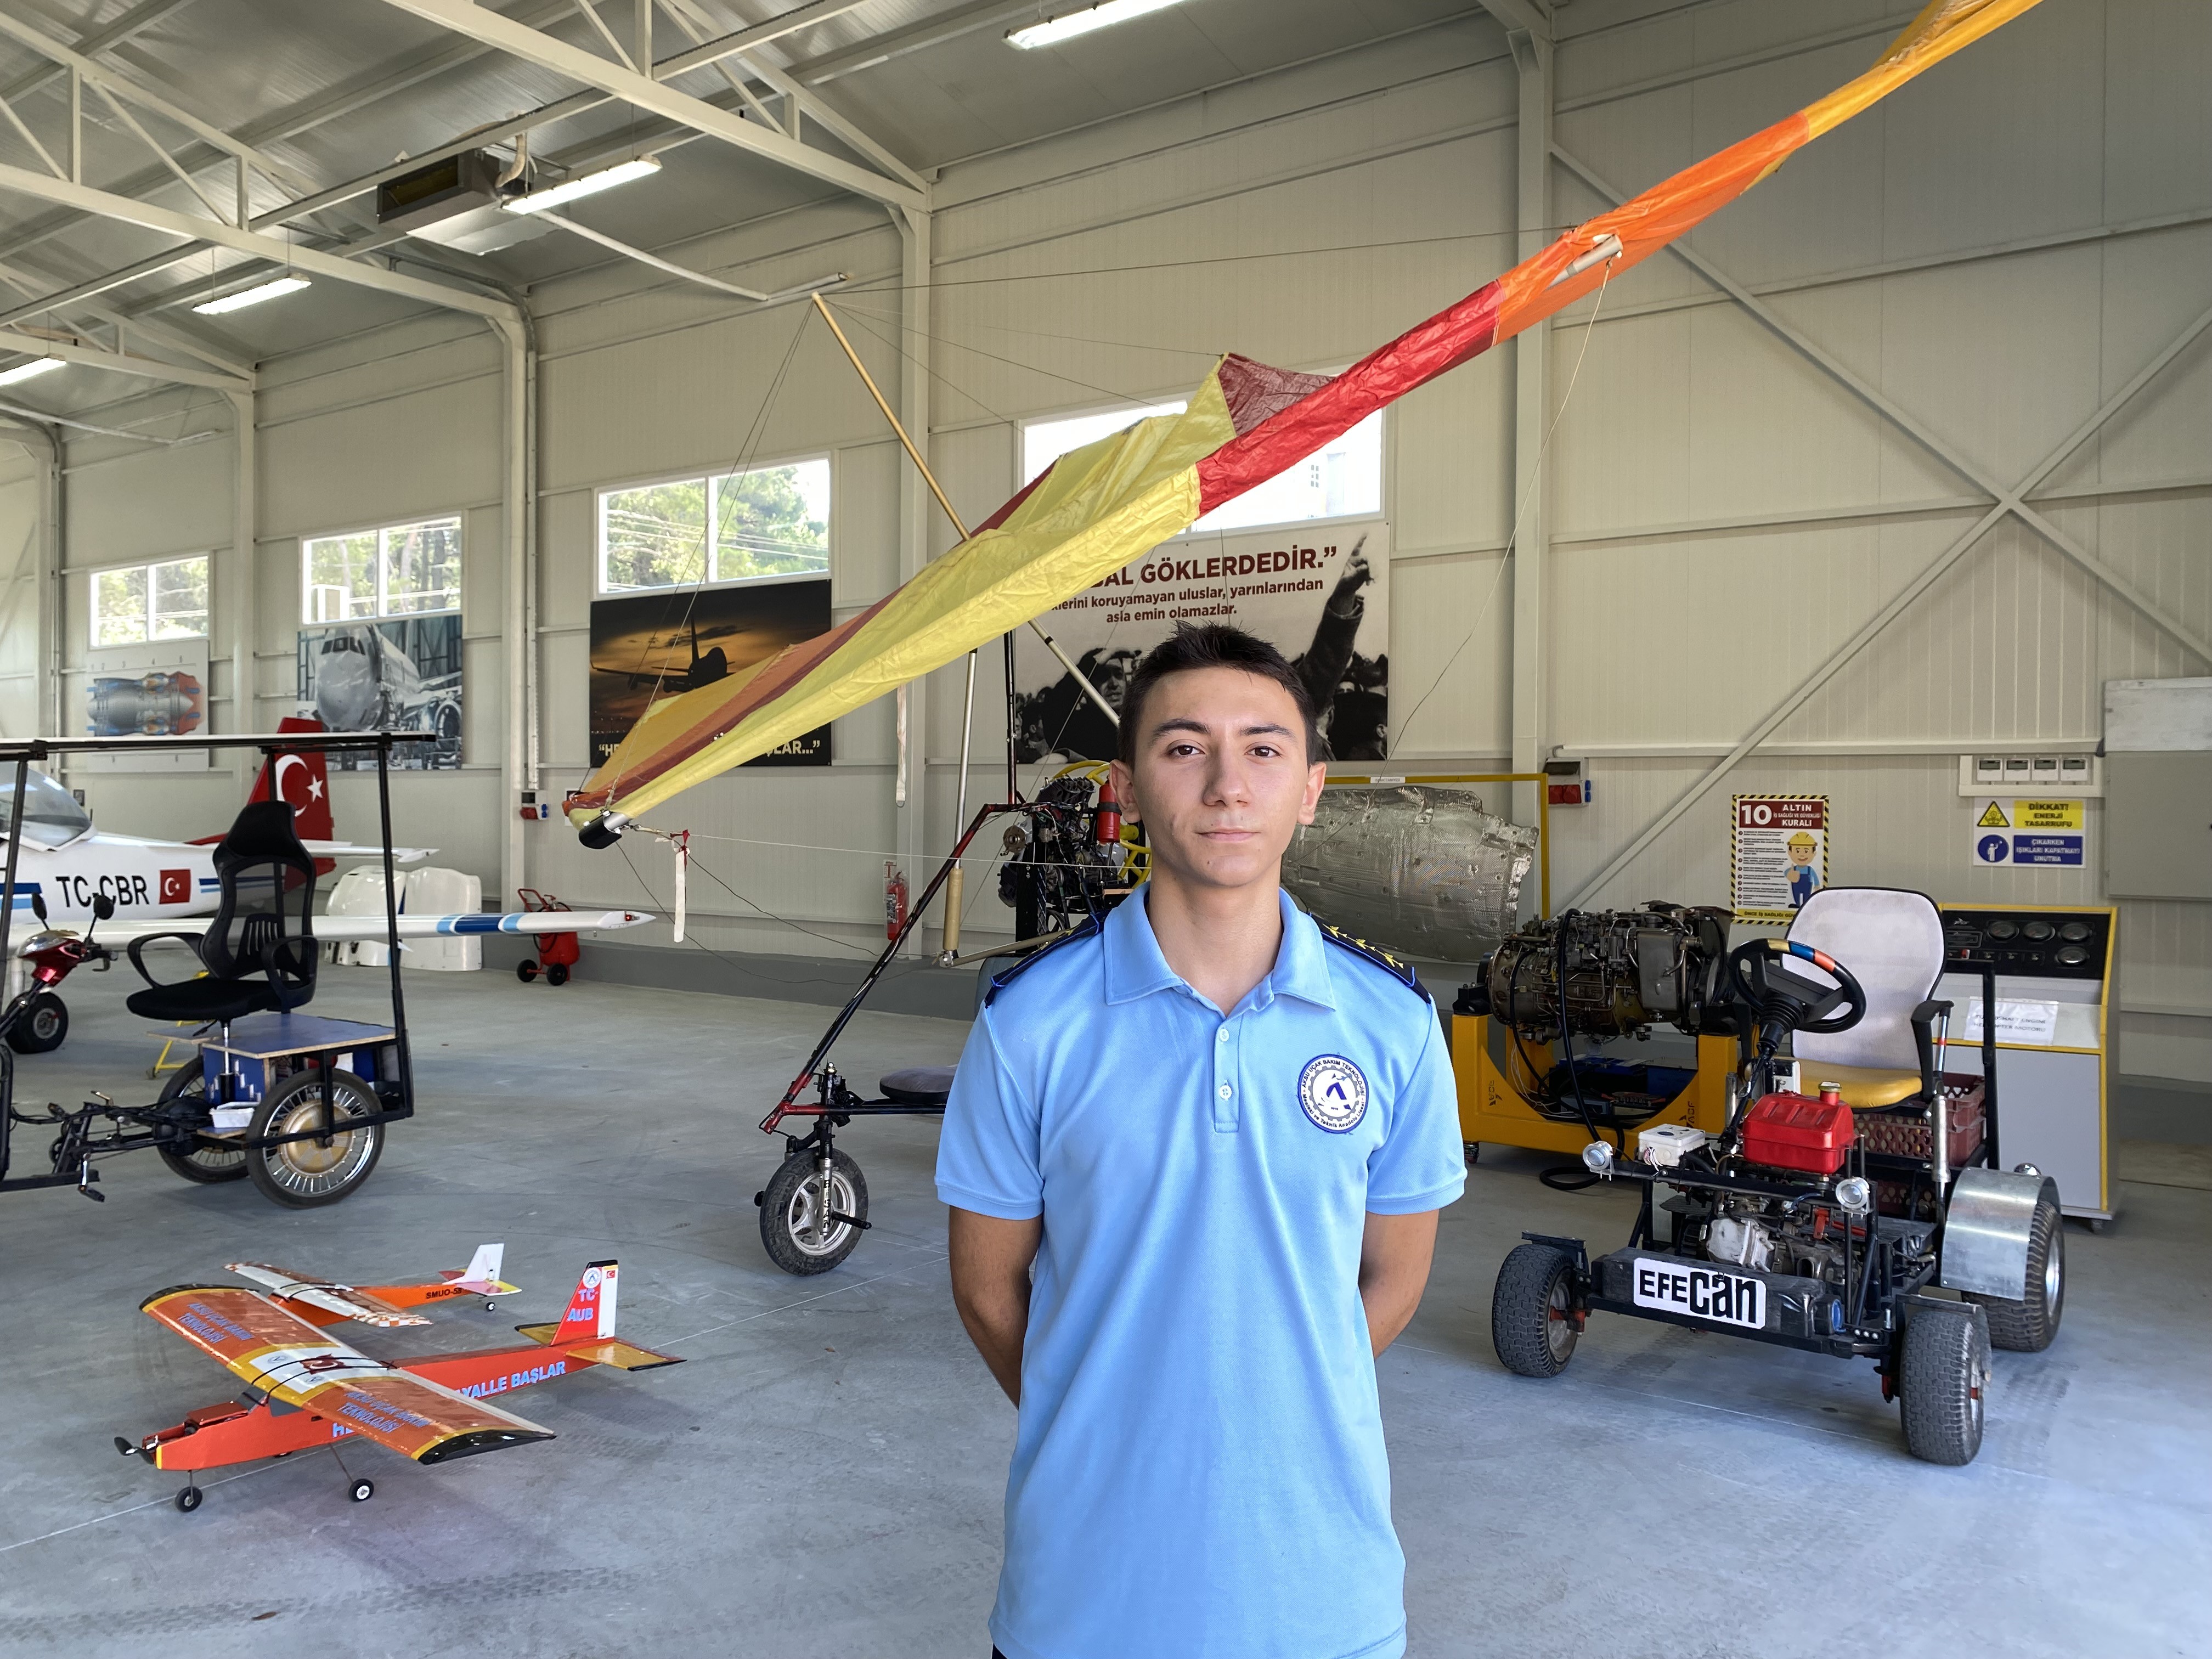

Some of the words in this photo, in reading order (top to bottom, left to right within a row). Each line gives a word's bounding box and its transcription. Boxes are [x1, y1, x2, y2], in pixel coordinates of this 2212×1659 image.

[1141, 545, 1336, 584] GÖKLERDEDİR.”
[1091, 591, 1175, 608] koruyamayan
[1179, 587, 1226, 600] uluslar,
[1229, 578, 1323, 599] yarınlarından
[1106, 611, 1131, 623] asla
[1134, 608, 1165, 621] emin
[1169, 603, 1237, 619] olamazlar.
[1741, 804, 1772, 825] 10
[55, 875, 150, 908] TC-CBR
[1310, 1061, 1322, 1072] UÇAK
[567, 1307, 593, 1322] AUB
[511, 1361, 566, 1387] BAŞLAR
